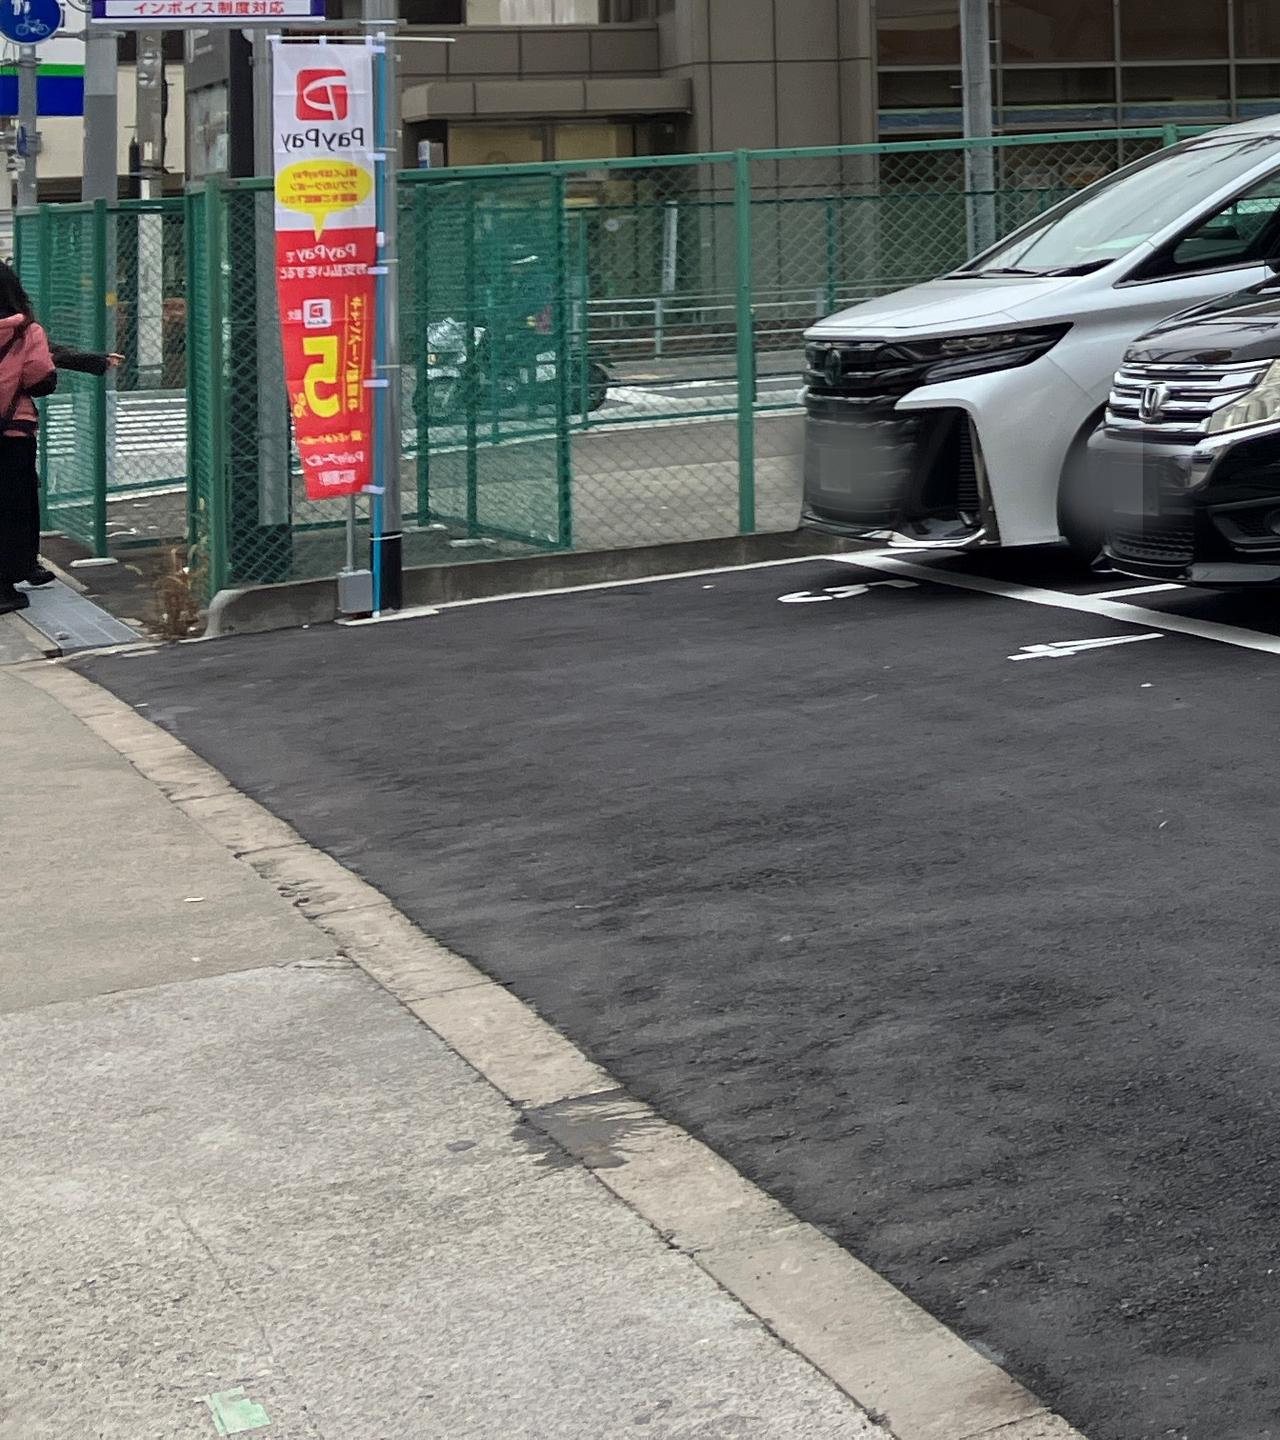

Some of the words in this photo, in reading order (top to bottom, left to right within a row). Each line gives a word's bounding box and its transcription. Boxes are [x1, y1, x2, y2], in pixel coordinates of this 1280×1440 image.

[133, 1, 284, 15] インボイス制度対応
